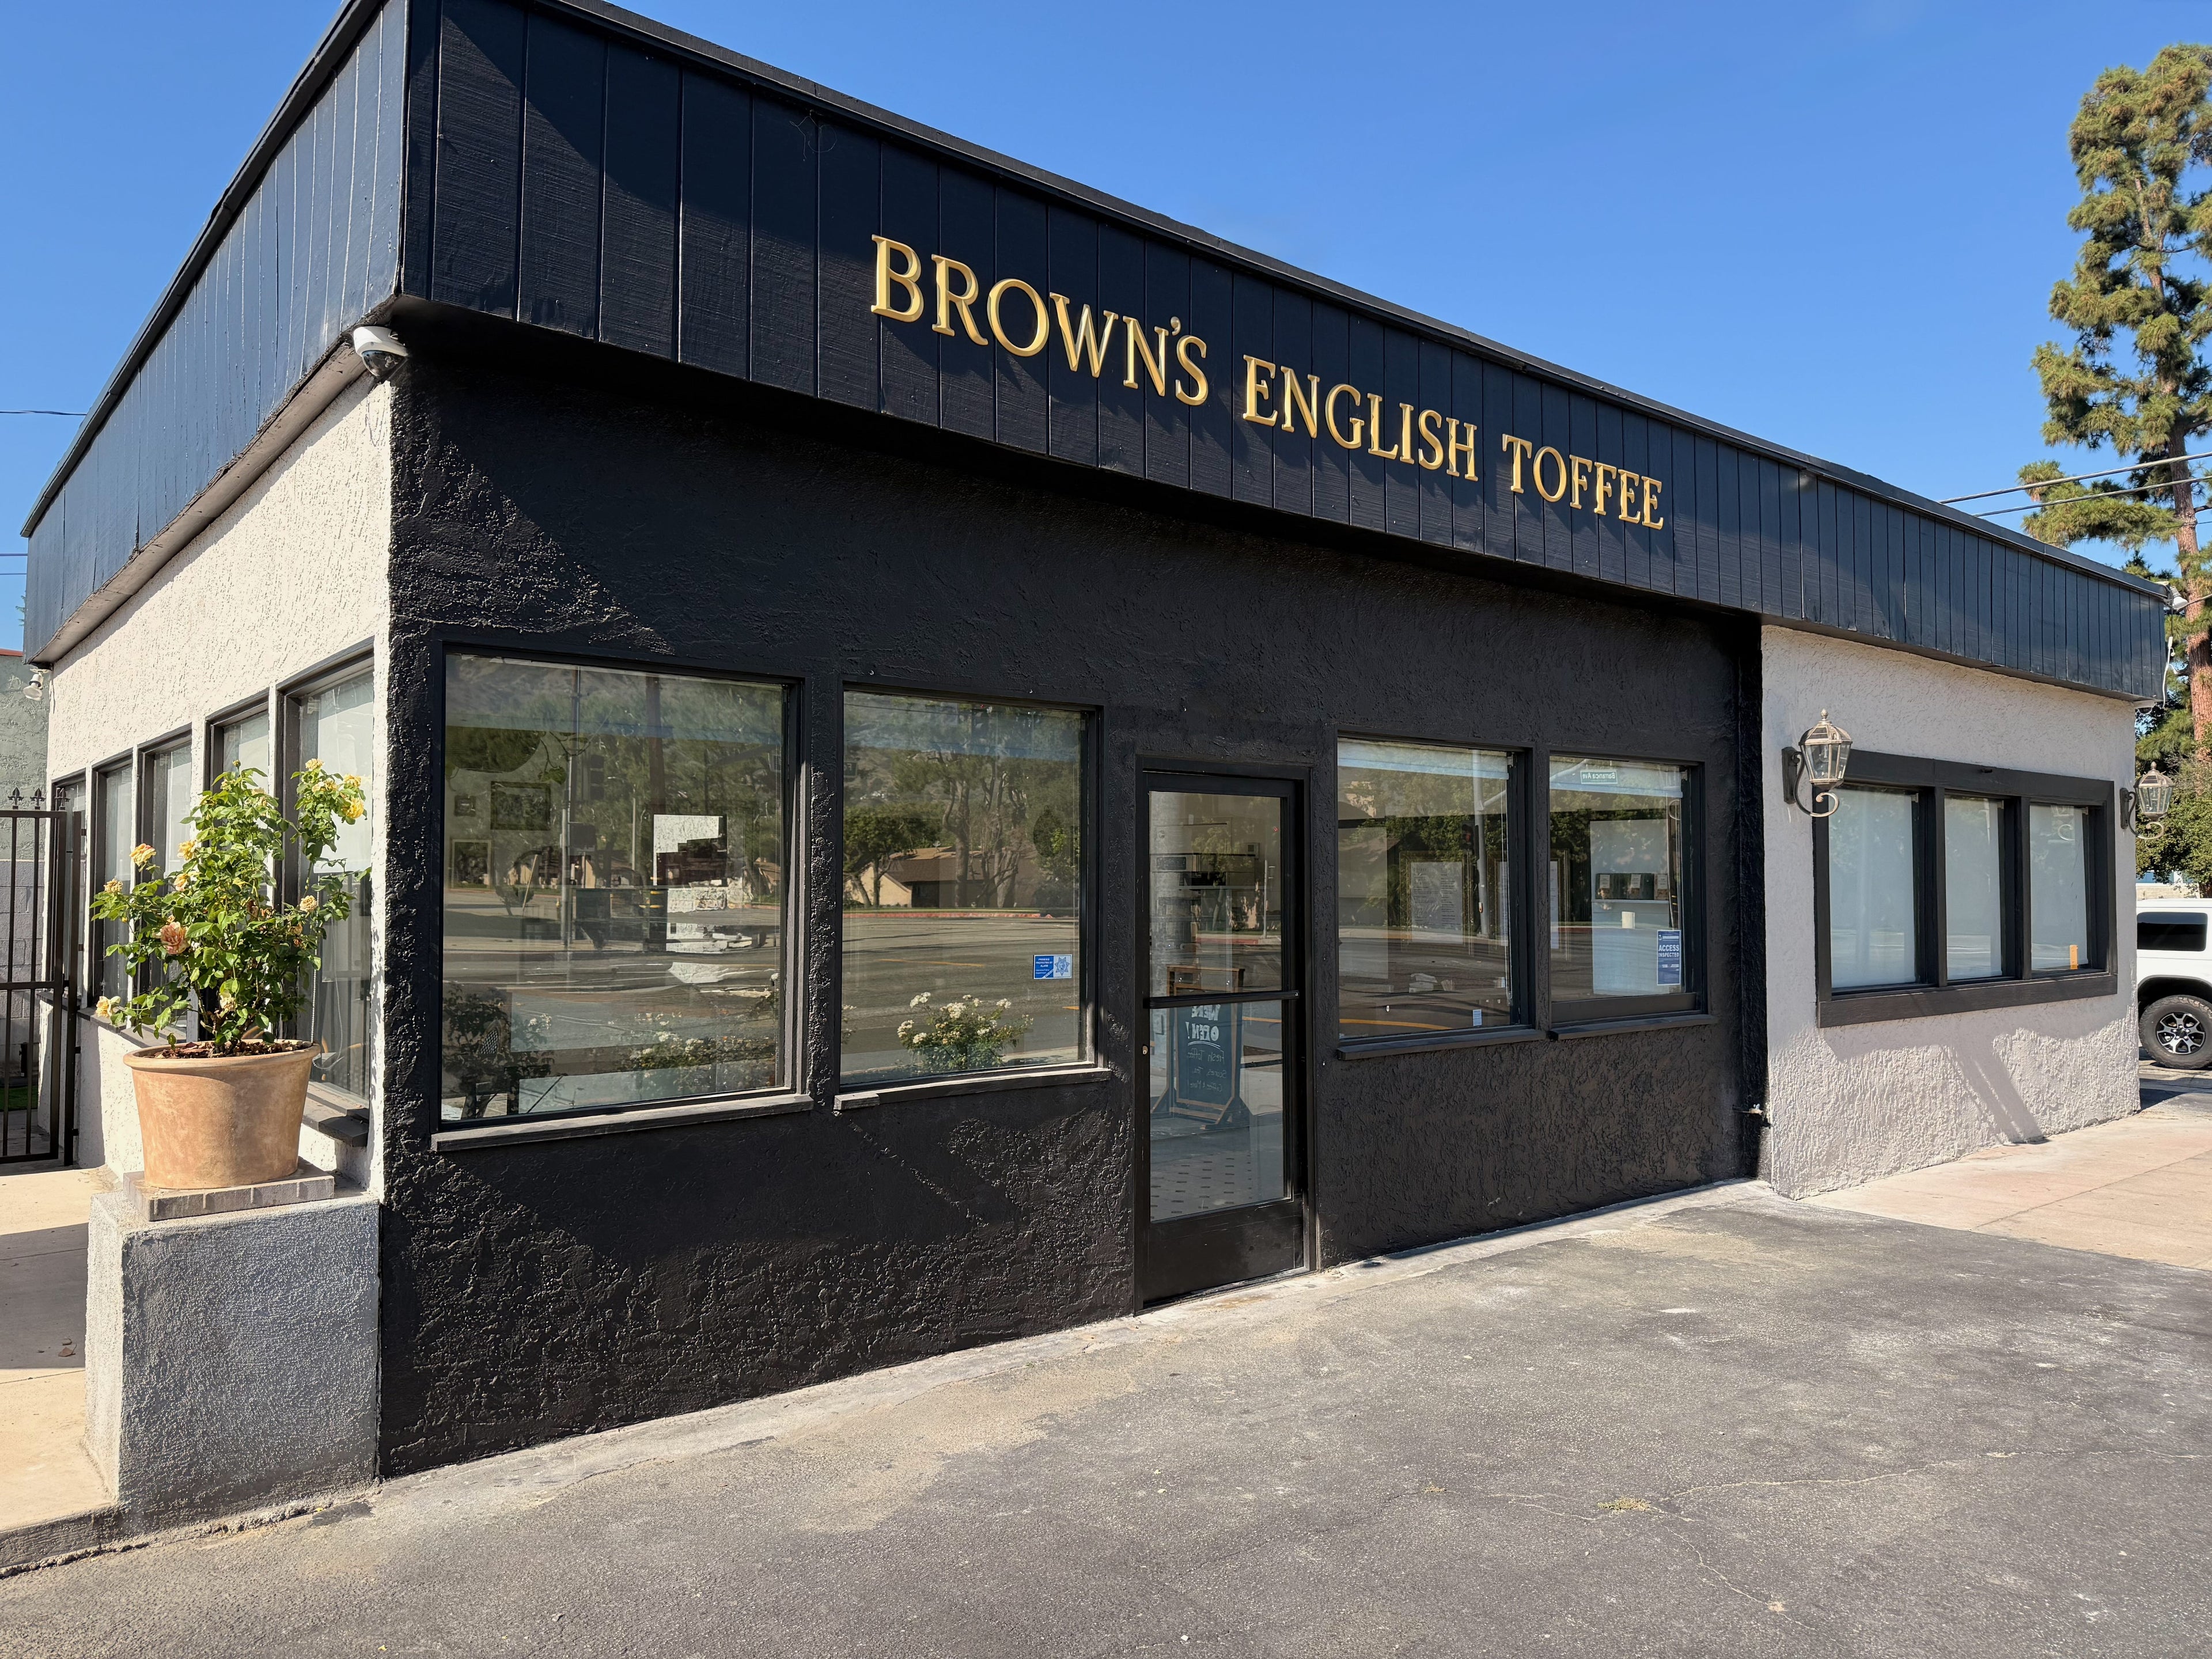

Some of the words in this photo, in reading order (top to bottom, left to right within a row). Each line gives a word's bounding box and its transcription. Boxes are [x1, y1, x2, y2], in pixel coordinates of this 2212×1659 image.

[871, 235, 1209, 406] BROWN'S
[1243, 355, 1479, 482] ENGLISH
[1502, 434, 1664, 530] TOFFEE
